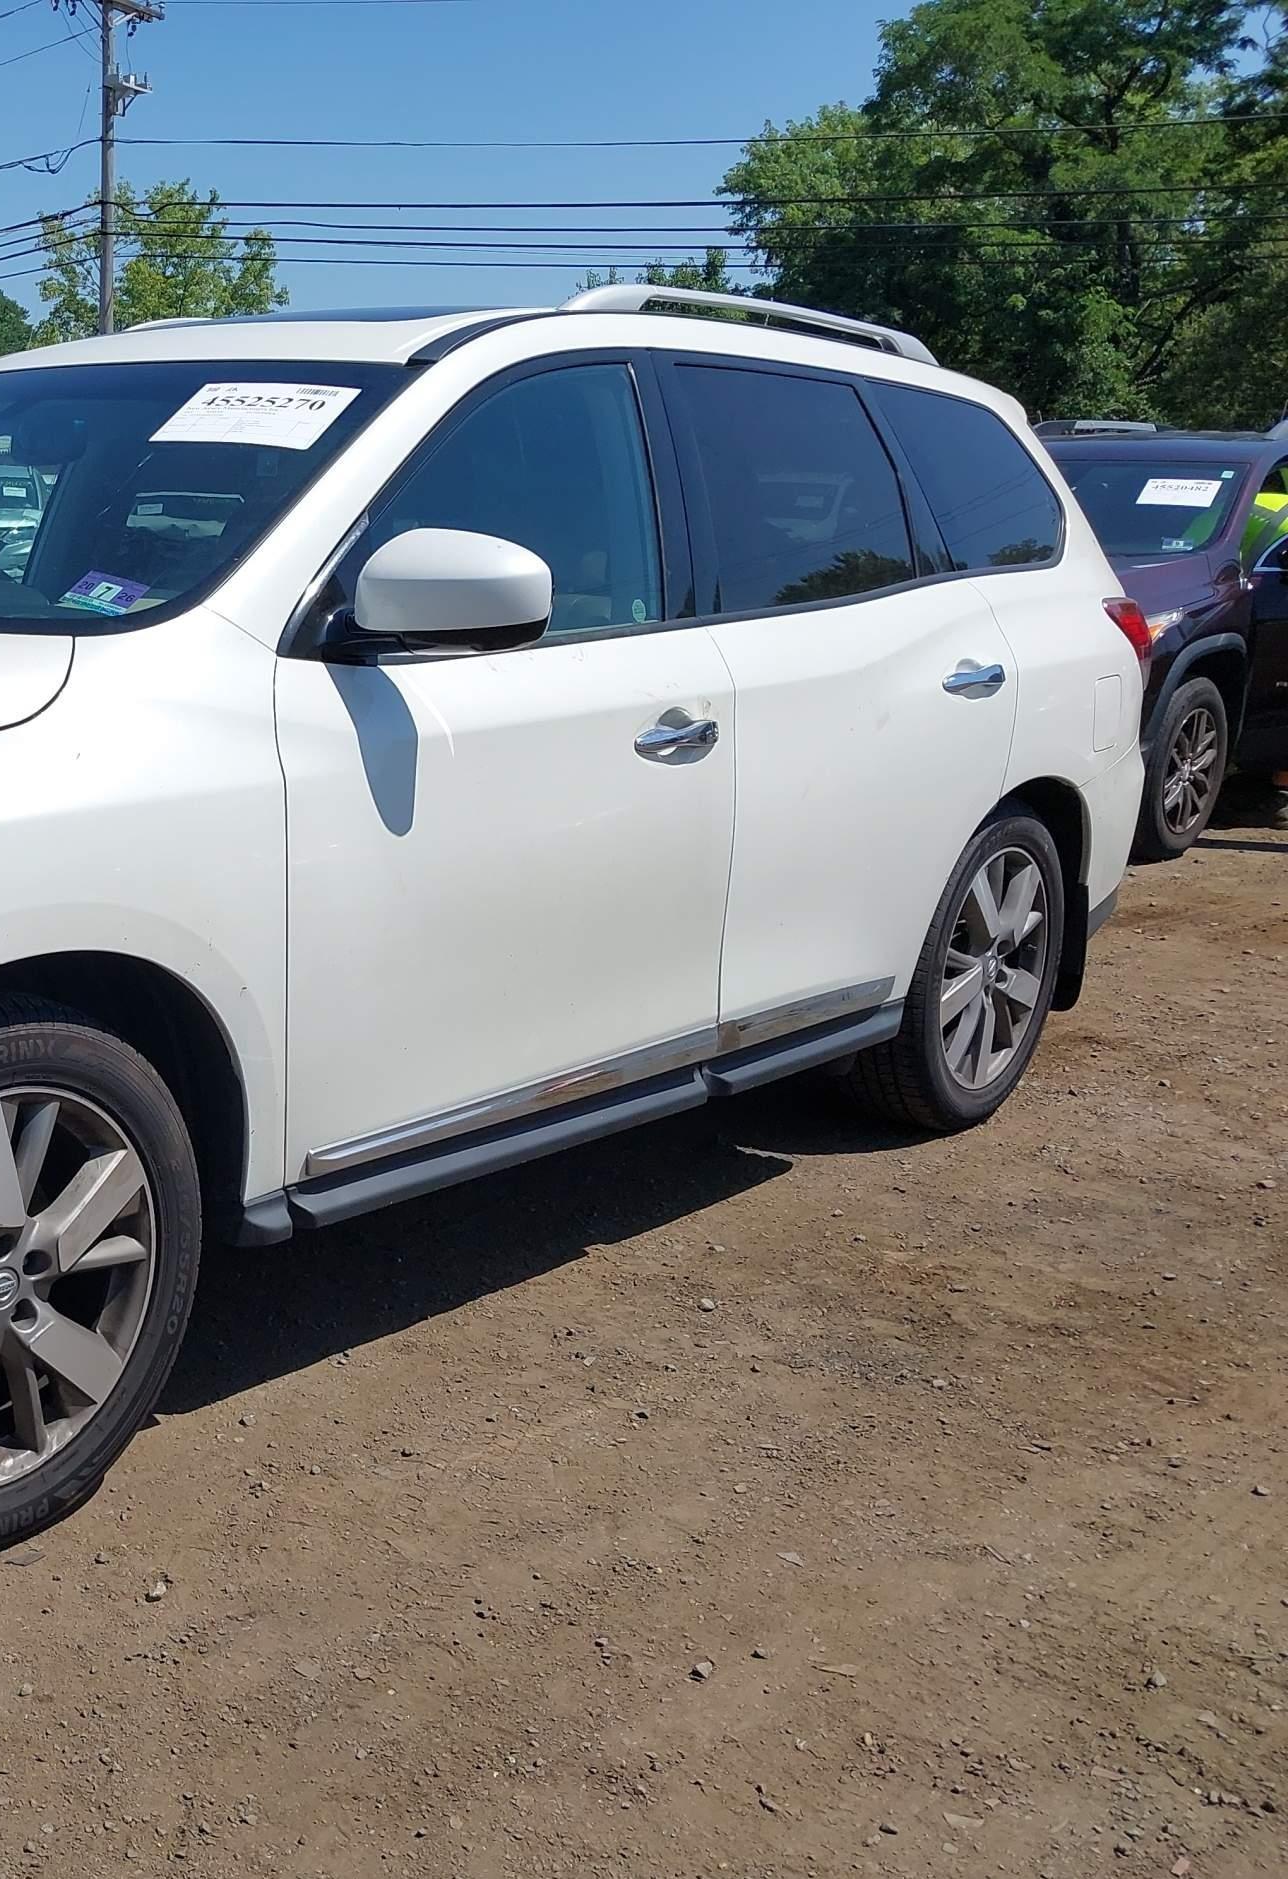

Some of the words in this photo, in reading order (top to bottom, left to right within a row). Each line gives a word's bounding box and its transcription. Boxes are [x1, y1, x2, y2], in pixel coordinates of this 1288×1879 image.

[202, 395, 326, 411] 45525270
[78, 581, 96, 591] 20
[96, 585, 114, 599] 7
[117, 593, 136, 602] 26
